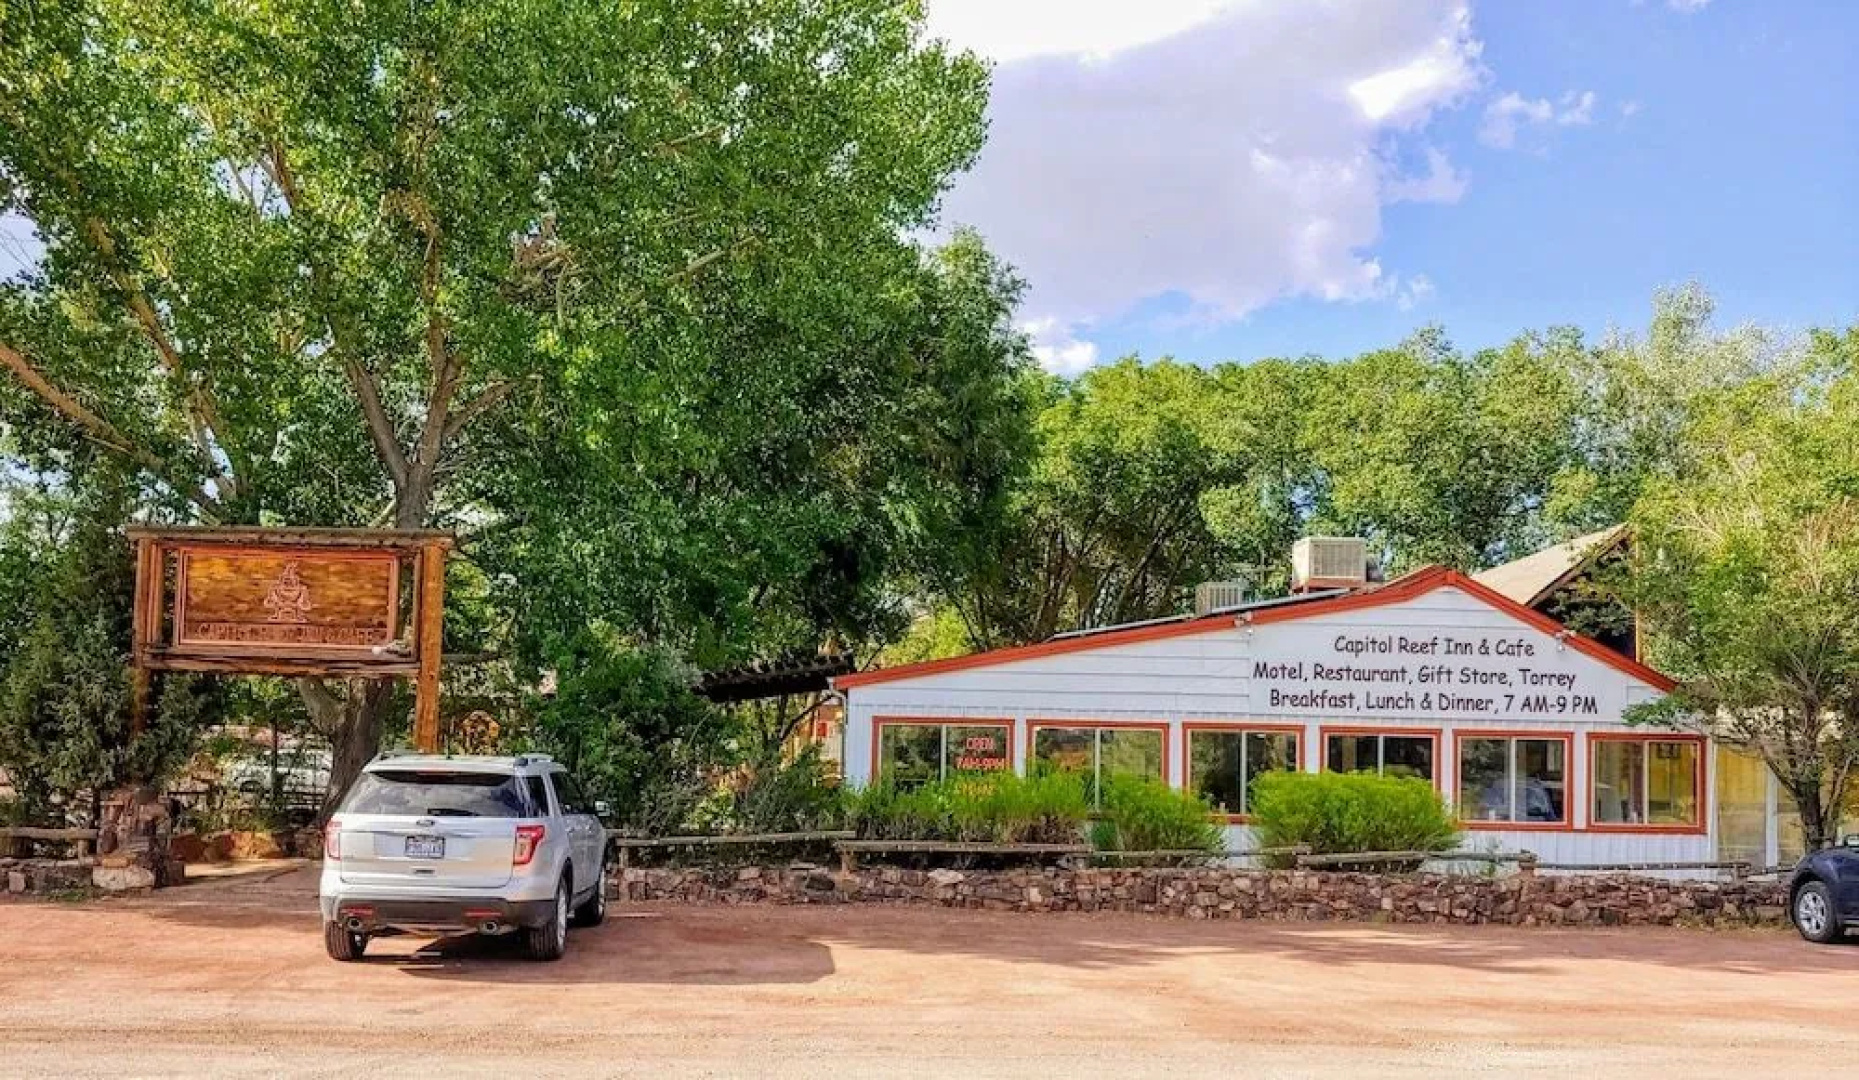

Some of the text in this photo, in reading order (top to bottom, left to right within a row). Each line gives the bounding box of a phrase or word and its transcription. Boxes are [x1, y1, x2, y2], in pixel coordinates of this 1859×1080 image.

[1334, 635, 1535, 658] Capitol Reef Inn & Cafe
[1252, 661, 1577, 691] Motel, Restaurant, Gift Store, Torrey
[1269, 688, 1598, 715] Breakfast, Lunch & Dinner, 7 AM-9 PM
[966, 737, 995, 750] OPEN
